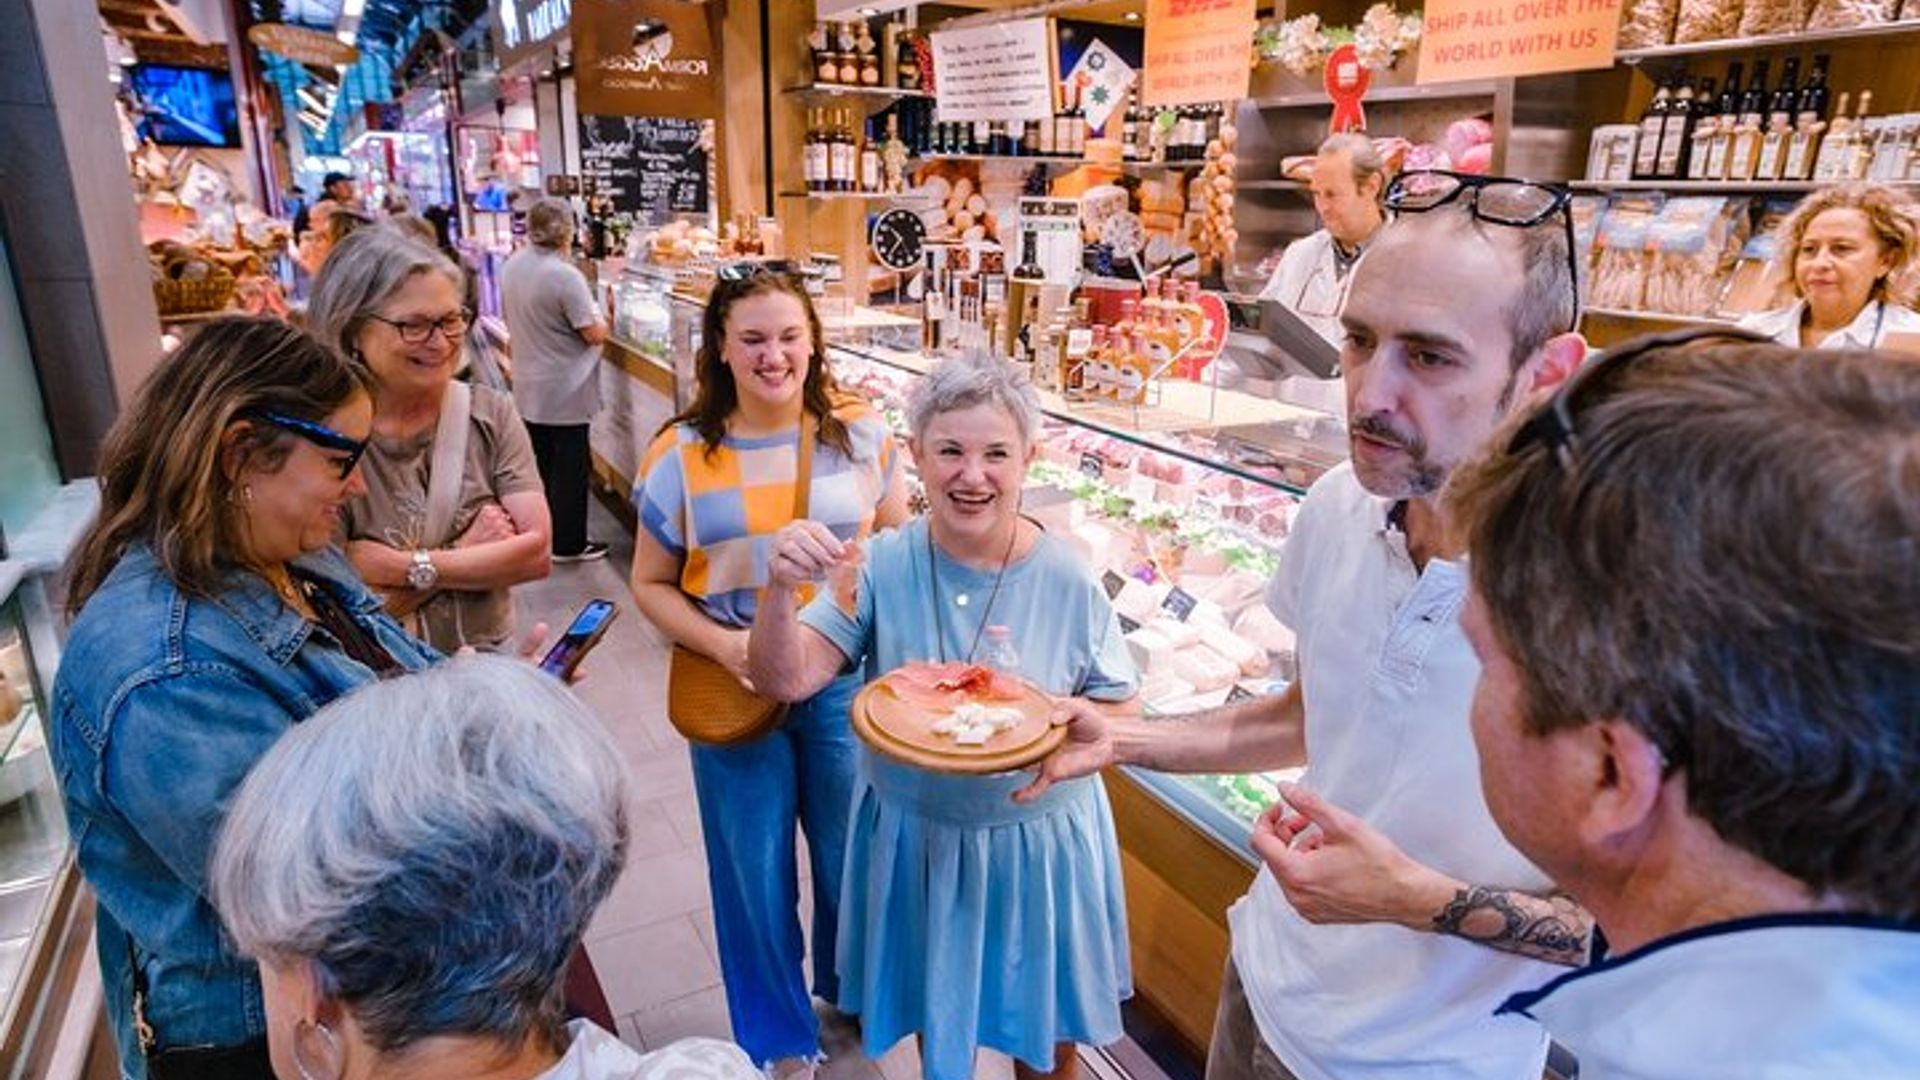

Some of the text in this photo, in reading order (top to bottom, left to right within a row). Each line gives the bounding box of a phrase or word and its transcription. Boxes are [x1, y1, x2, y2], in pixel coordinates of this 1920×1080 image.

[1426, 11, 1467, 34] SHIP
[1472, 9, 1504, 28] ALL
[1513, 0, 1568, 23] OVER
[1434, 28, 1598, 64] WORLD WITH US
